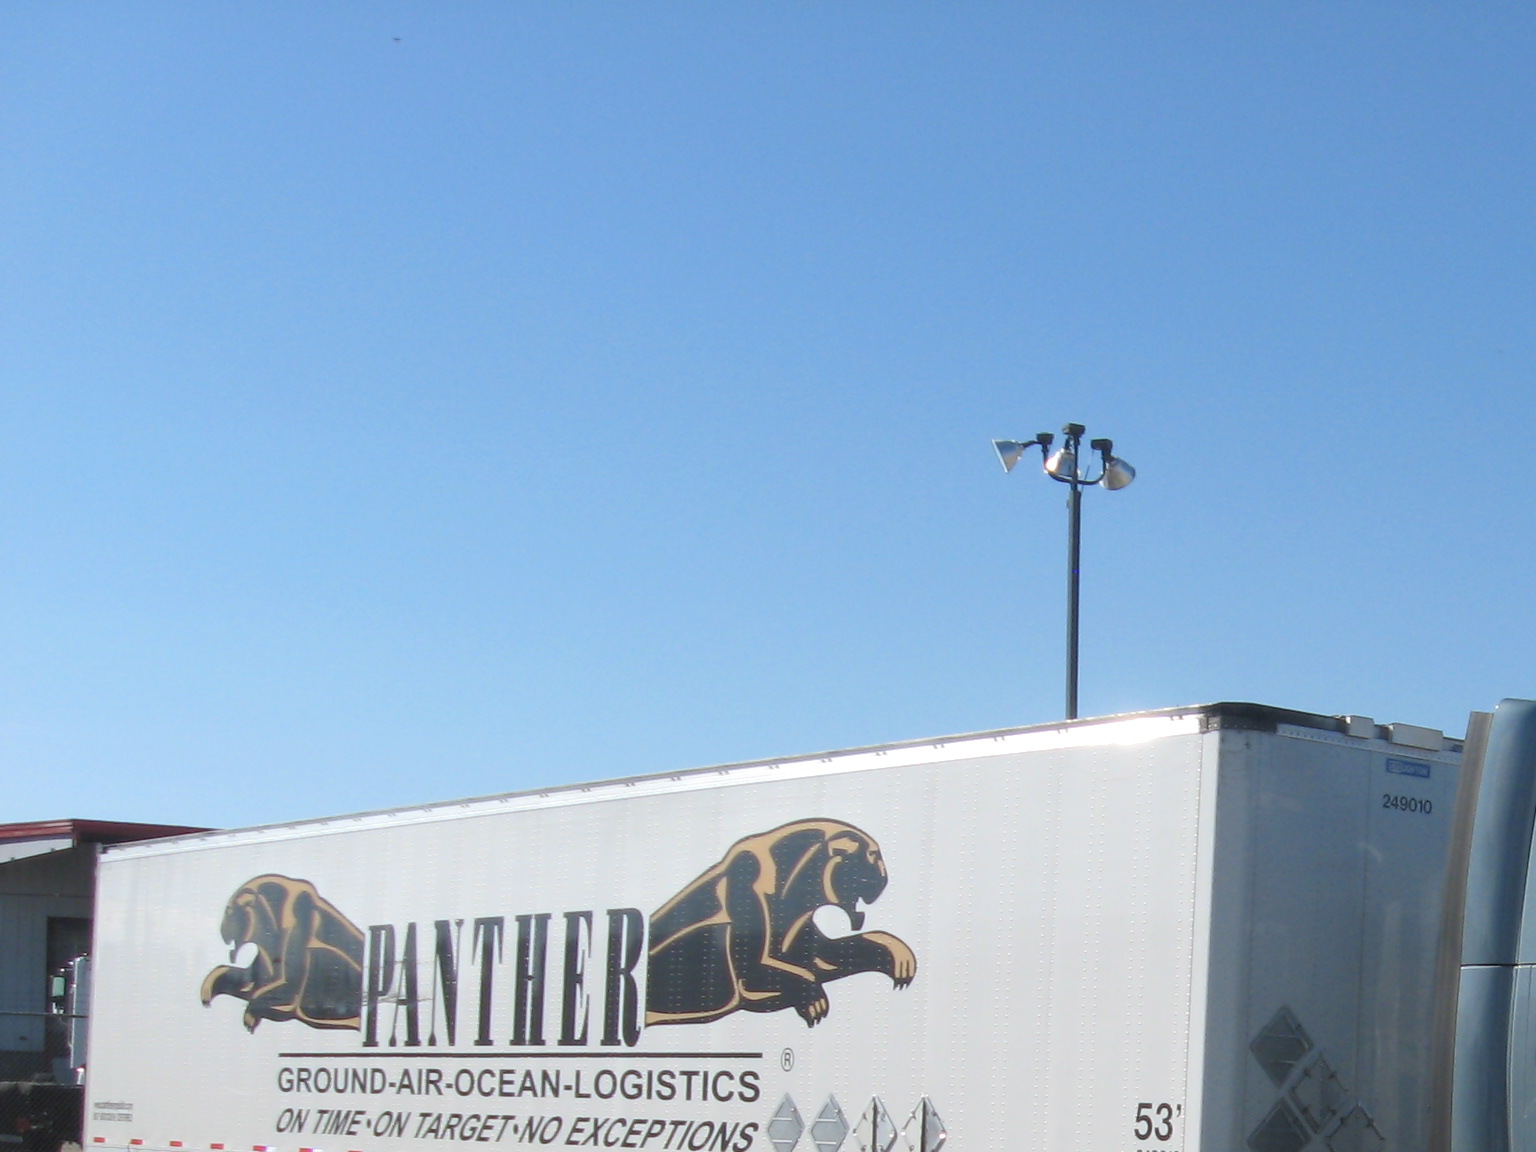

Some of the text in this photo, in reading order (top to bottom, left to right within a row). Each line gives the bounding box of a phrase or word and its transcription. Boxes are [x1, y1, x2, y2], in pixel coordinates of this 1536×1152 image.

[1382, 793, 1433, 815] 249010
[362, 907, 645, 1048] PANTHER
[277, 1067, 761, 1103] GROUND-AIR-OCEAN-LOGISTICS
[276, 1108, 311, 1133] ON
[564, 1117, 760, 1152] EXCEPTIONS
[1133, 1102, 1182, 1142] 53'
